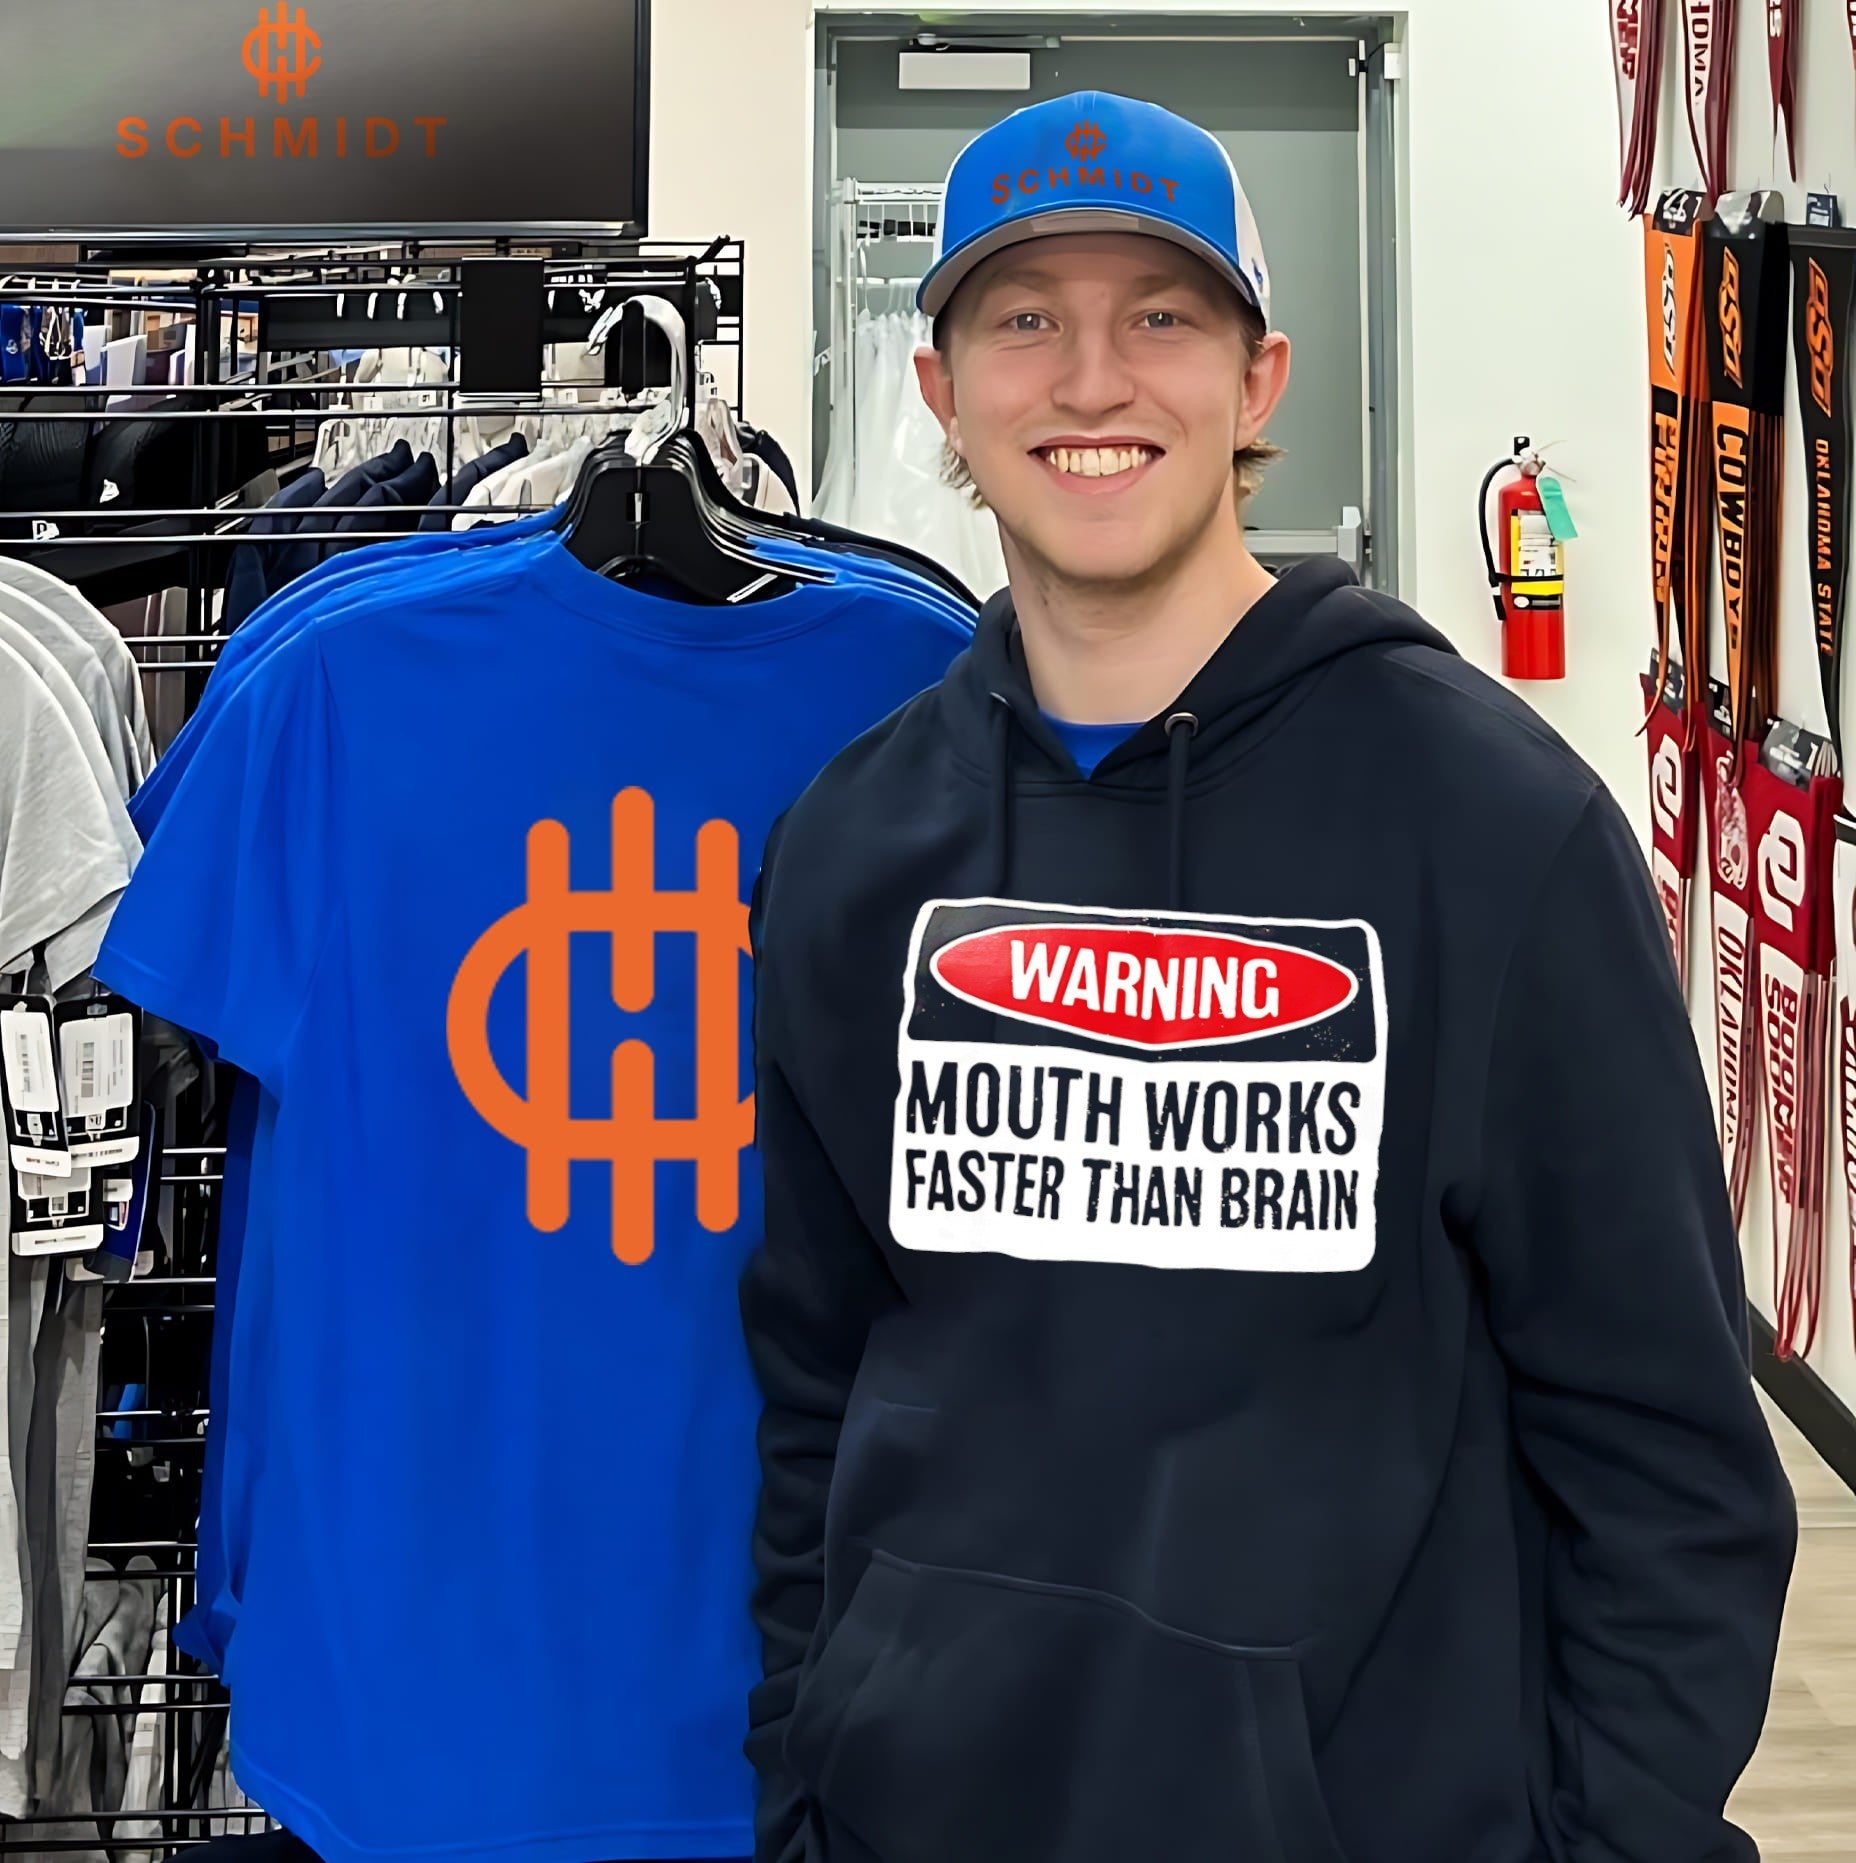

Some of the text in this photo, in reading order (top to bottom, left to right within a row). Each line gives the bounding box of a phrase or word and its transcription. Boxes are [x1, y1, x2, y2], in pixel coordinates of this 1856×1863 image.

[115, 116, 448, 159] SCHMIDT
[991, 167, 1179, 204] SCHMIDT
[1010, 939, 1280, 1022] WARNING
[905, 1060, 1362, 1155] MOUTH WORKS
[905, 1148, 1360, 1231] FASTER THAN BRAIN
